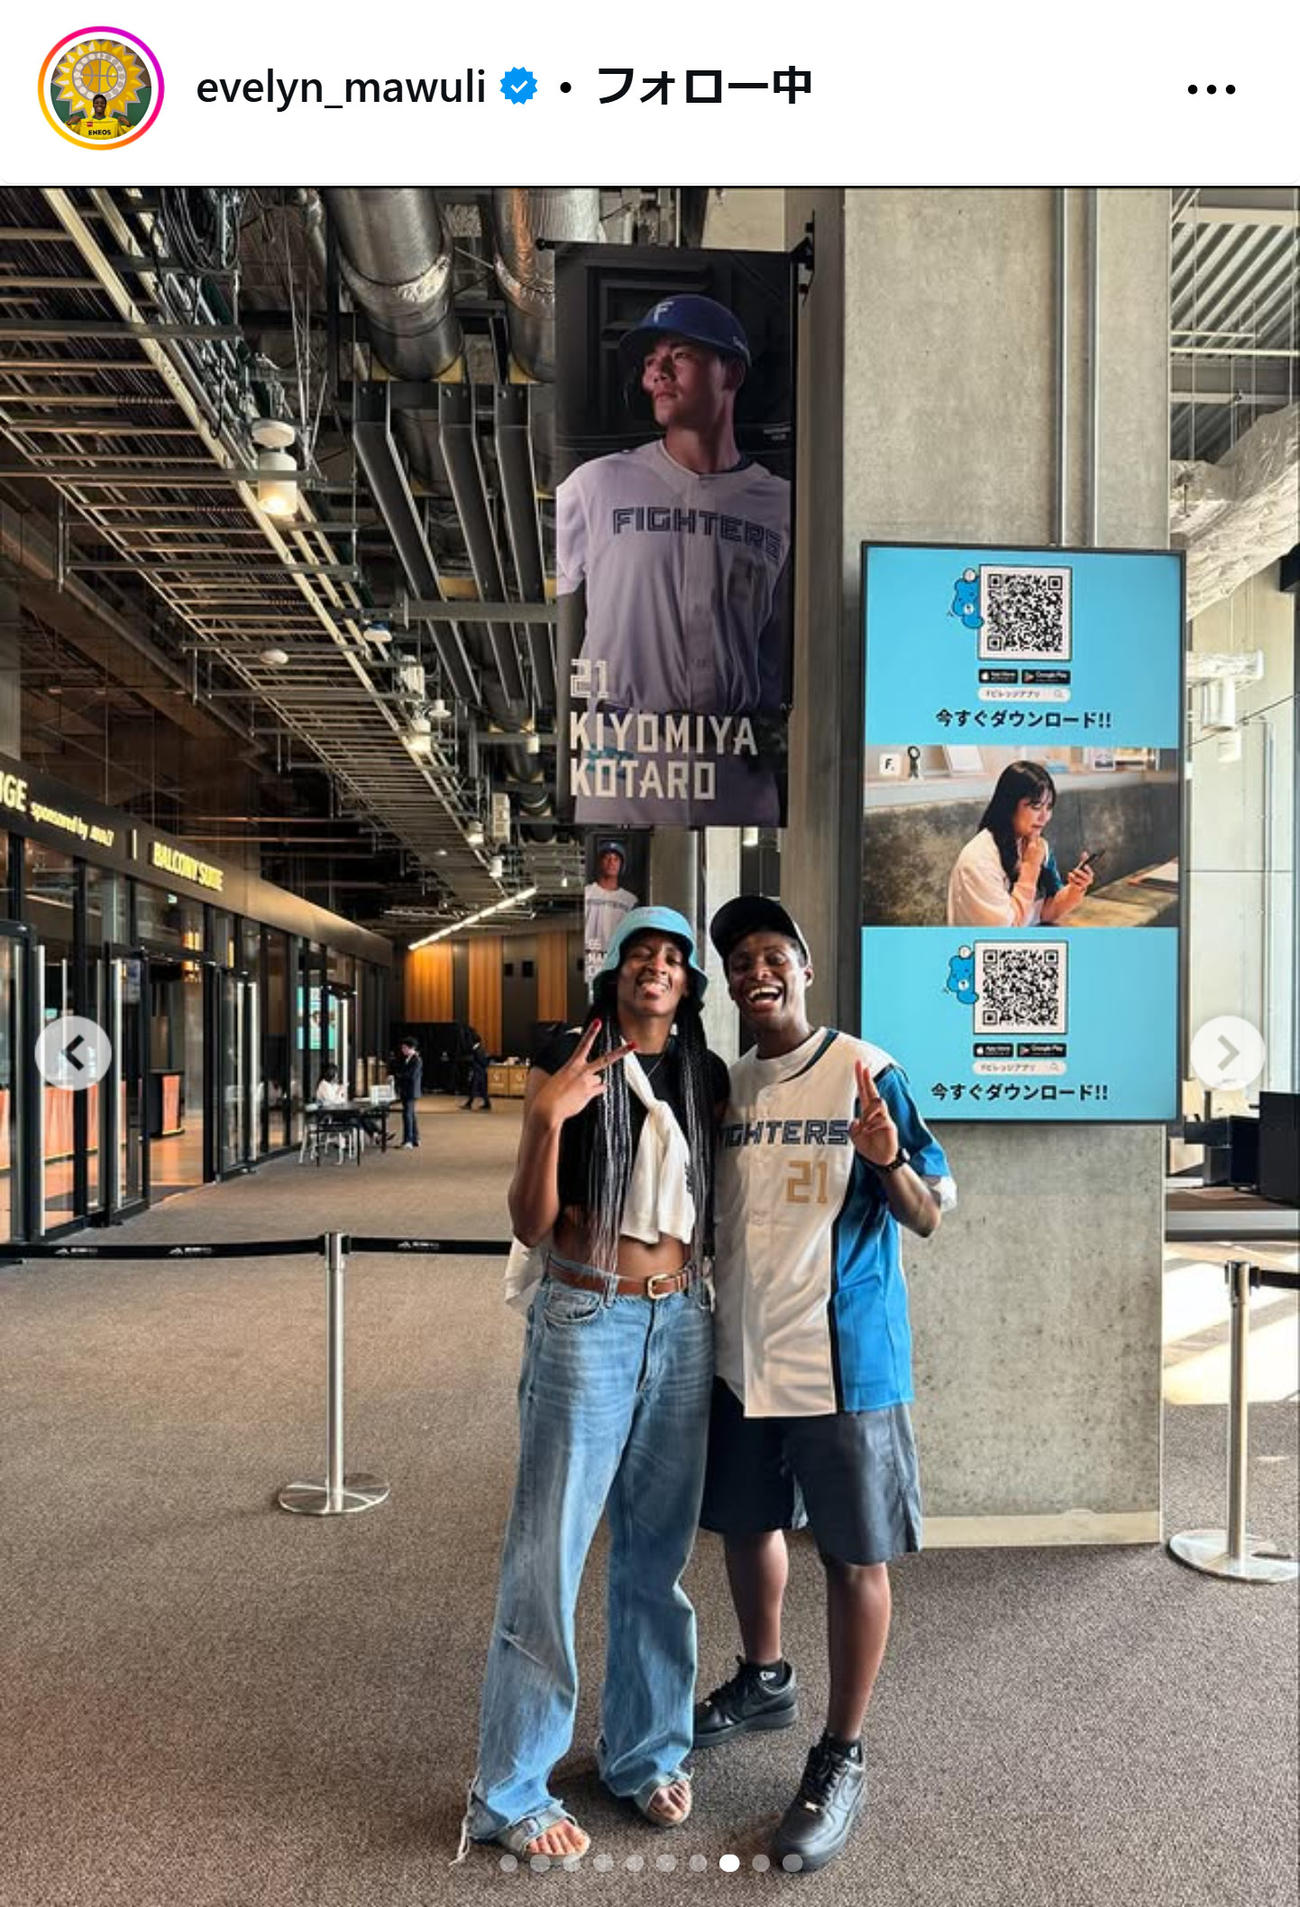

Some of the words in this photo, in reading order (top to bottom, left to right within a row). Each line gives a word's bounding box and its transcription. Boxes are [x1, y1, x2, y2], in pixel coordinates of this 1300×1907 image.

[612, 506, 782, 561] FIGHTERS
[570, 658, 609, 698] 21
[570, 711, 758, 755] KIYOMIYA
[570, 758, 716, 800] KOTARO
[786, 1160, 828, 1204] 21
